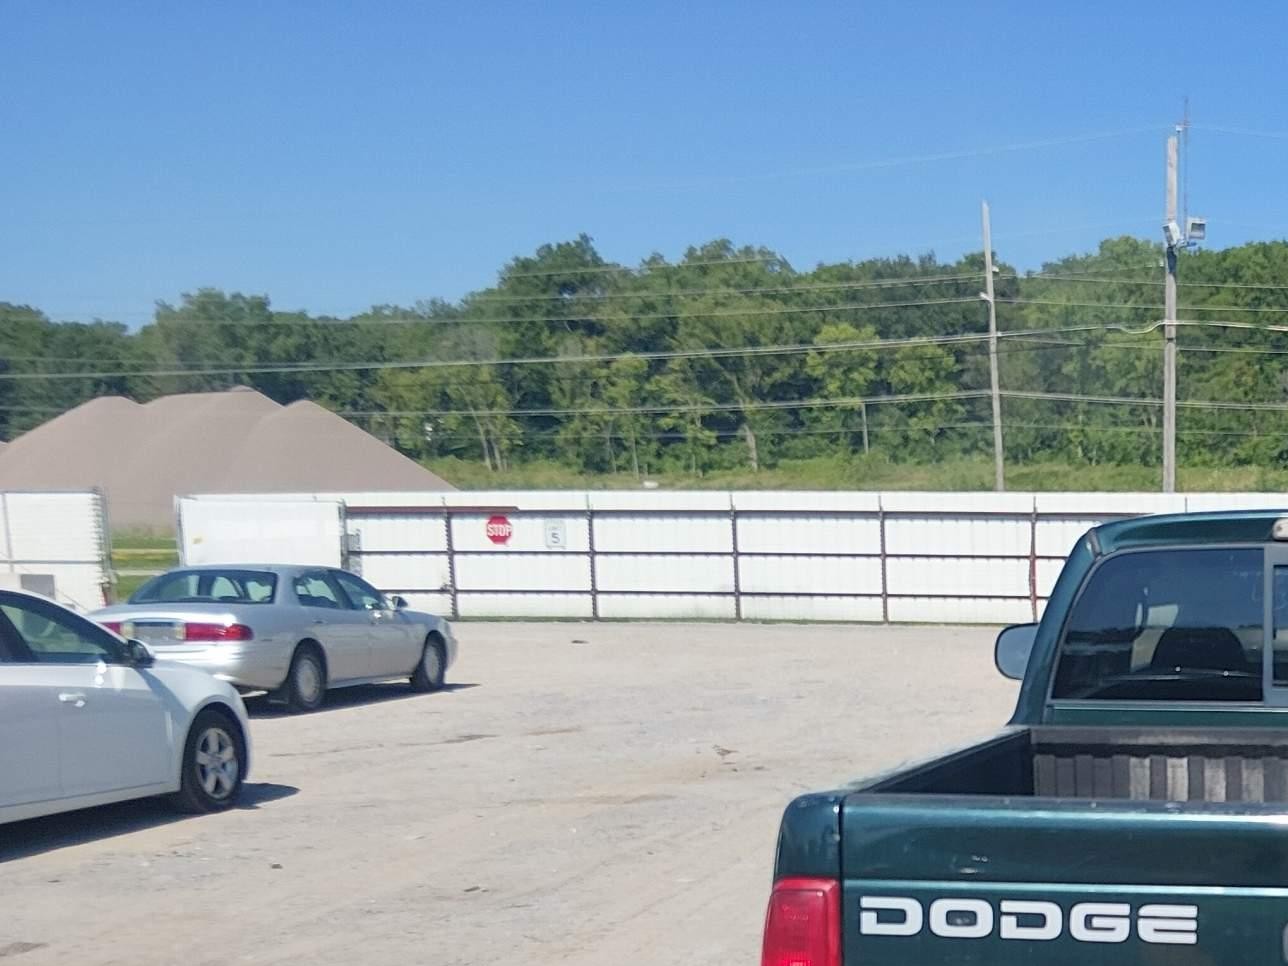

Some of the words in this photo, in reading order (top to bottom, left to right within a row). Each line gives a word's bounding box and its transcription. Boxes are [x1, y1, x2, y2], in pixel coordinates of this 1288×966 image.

[487, 523, 512, 537] STOP
[551, 532, 561, 544] 5
[860, 896, 1198, 945] DODGE
